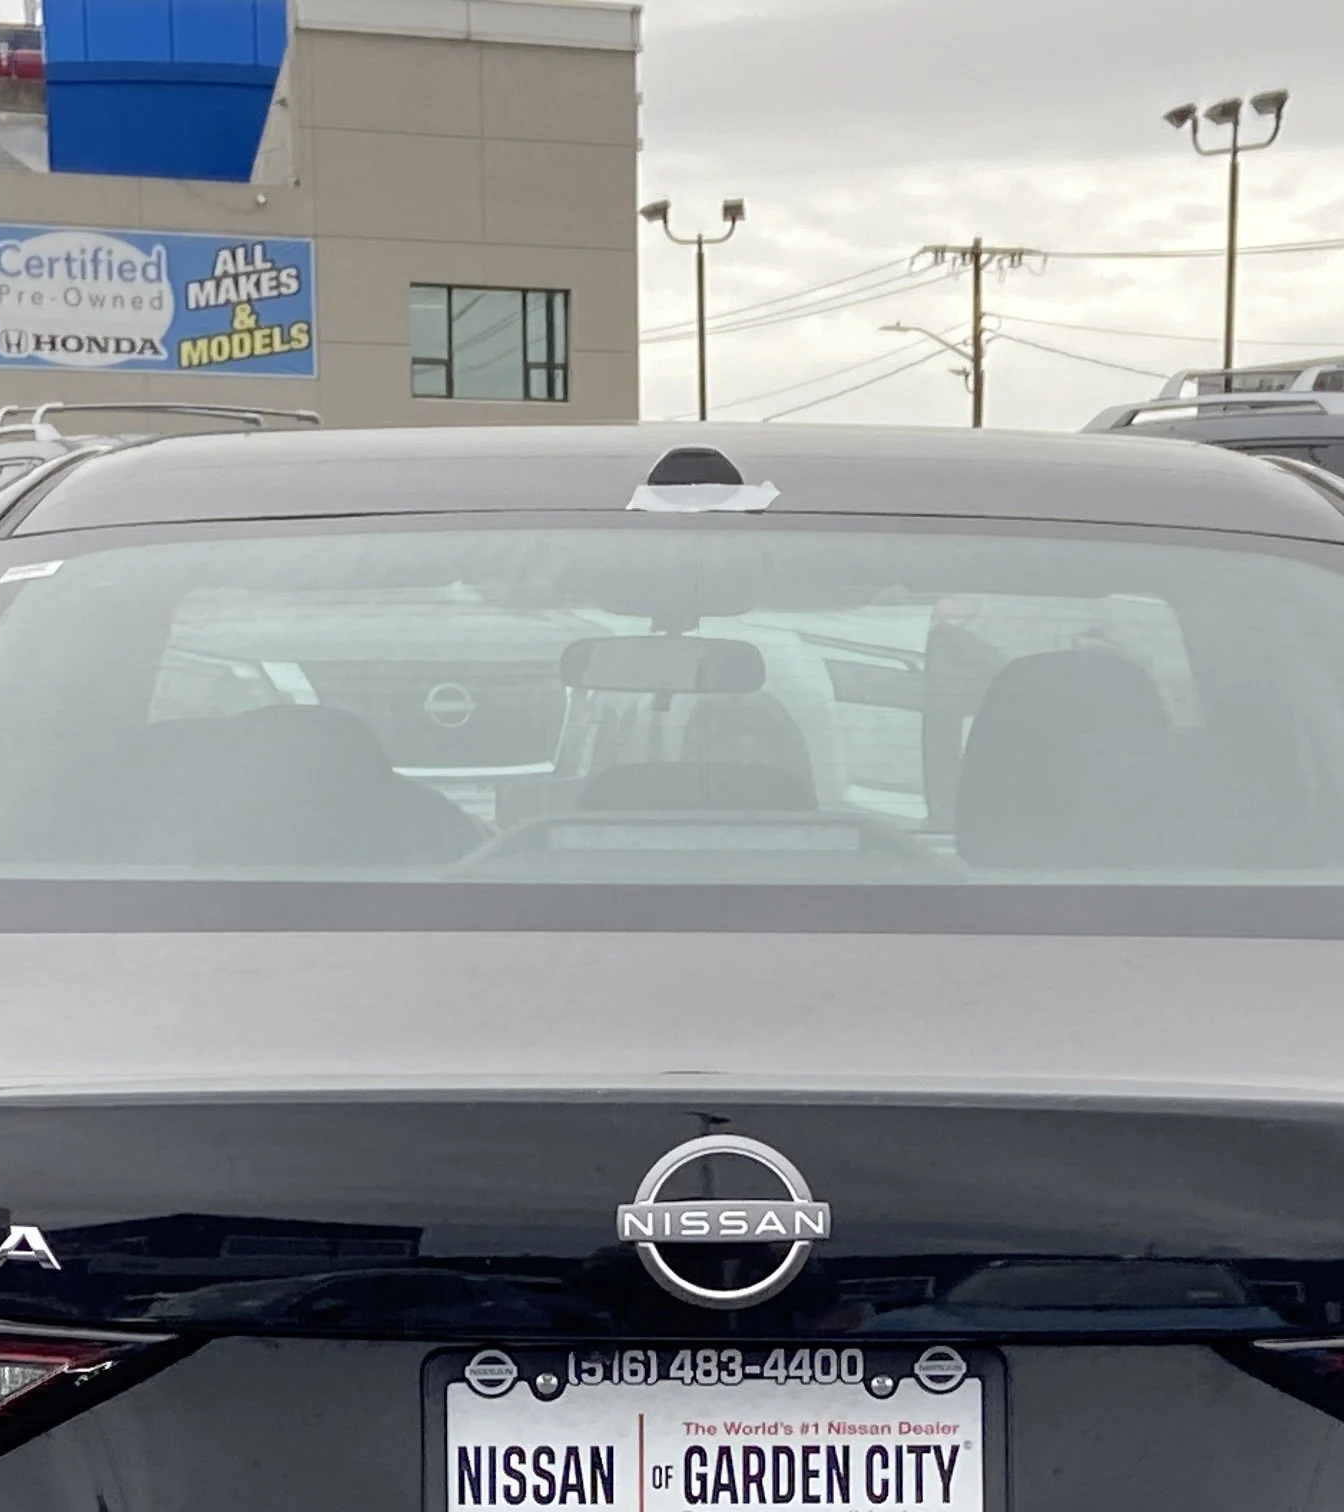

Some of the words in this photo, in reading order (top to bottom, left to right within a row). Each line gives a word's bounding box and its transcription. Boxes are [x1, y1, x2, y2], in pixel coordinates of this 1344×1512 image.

[213, 242, 274, 278] ALL
[187, 267, 301, 310] MAKES
[232, 303, 258, 331] &
[32, 333, 163, 356] HONDA
[179, 322, 311, 369] MODELS
[623, 1210, 824, 1237] NISSAN
[568, 1349, 659, 1386] (516)
[669, 1348, 865, 1386] 483-4400
[683, 1421, 717, 1436] The
[723, 1421, 794, 1436] World's
[800, 1421, 820, 1436] #1
[827, 1420, 892, 1436] Nissan
[898, 1421, 960, 1436] Dealer
[457, 1445, 615, 1506] NISSAN
[652, 1465, 674, 1490] OF
[683, 1444, 851, 1506] GARDEN
[866, 1444, 961, 1505] CITY
